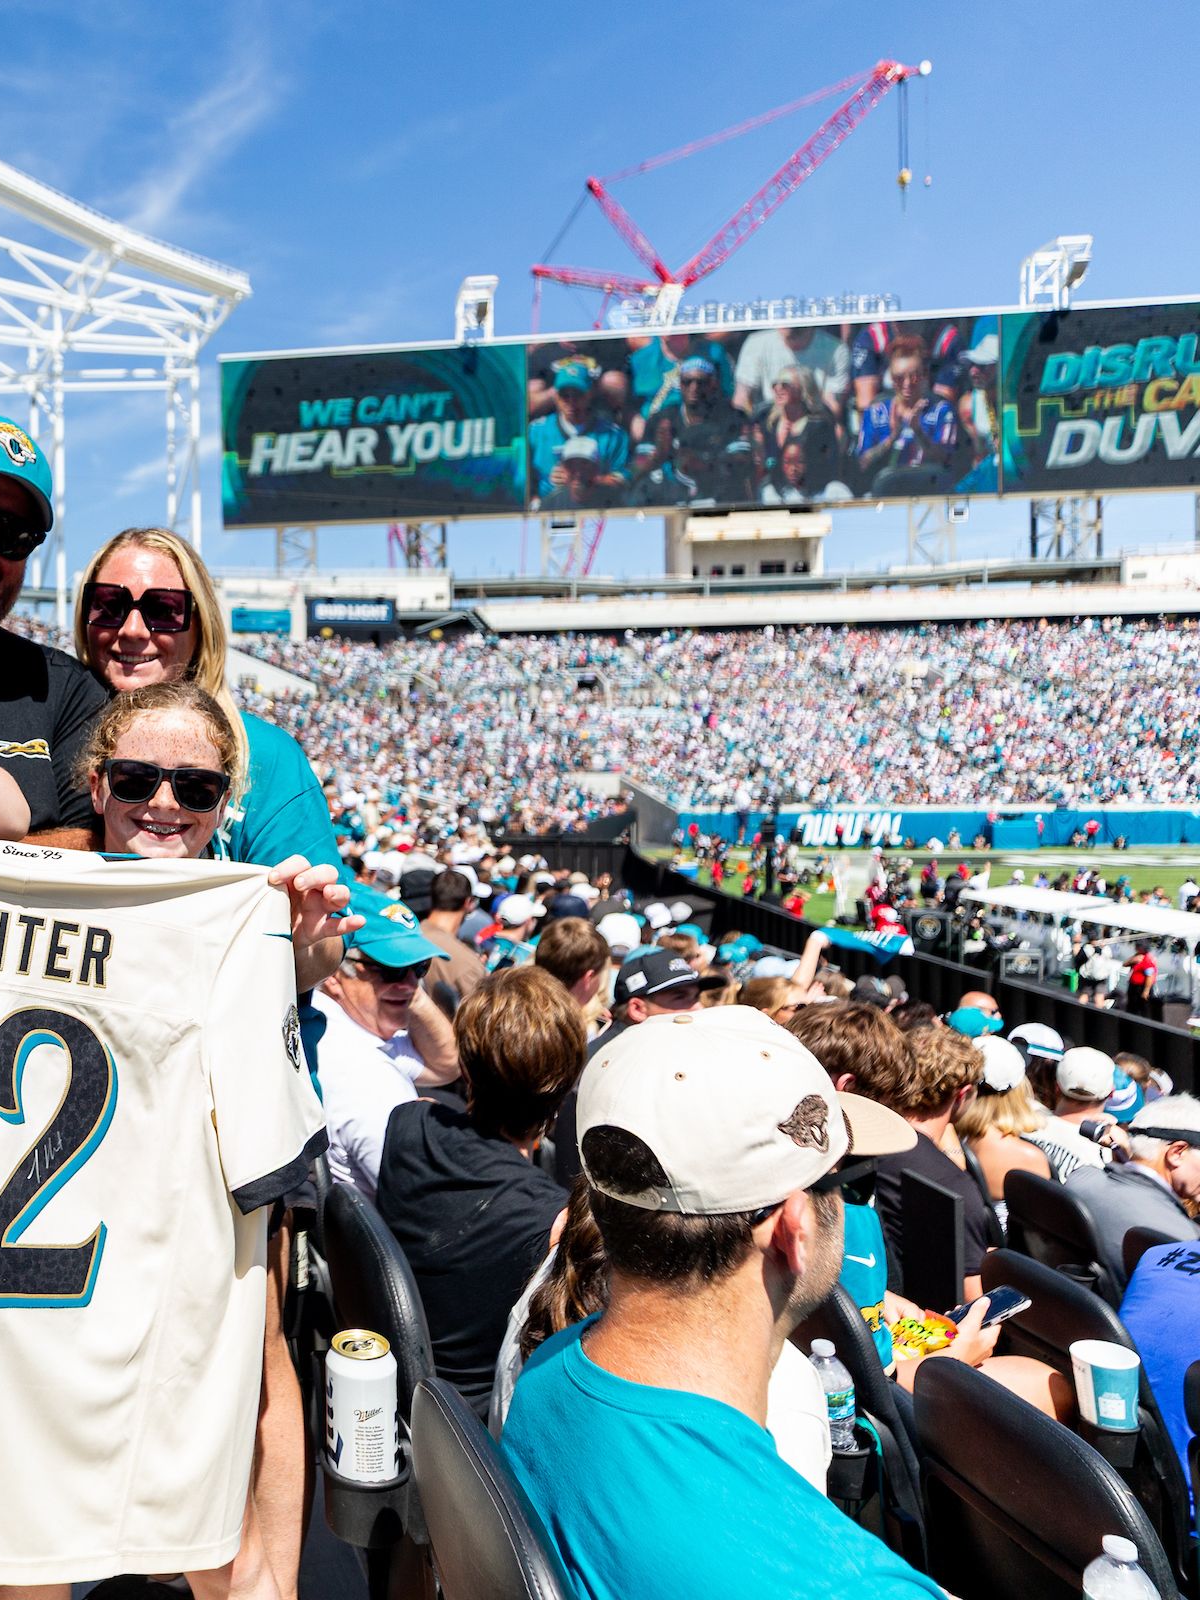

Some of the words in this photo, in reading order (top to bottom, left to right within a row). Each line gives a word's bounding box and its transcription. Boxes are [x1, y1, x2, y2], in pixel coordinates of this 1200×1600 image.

[300, 398, 355, 428] WE
[357, 391, 453, 424] CAN'T
[248, 426, 379, 476] HEAR
[386, 416, 497, 464] YOU!!
[1046, 409, 1200, 470] DUV
[315, 603, 346, 621] BUD
[2, 845, 40, 858] Since
[41, 849, 63, 860] '95
[353, 1406, 384, 1423] Miller
